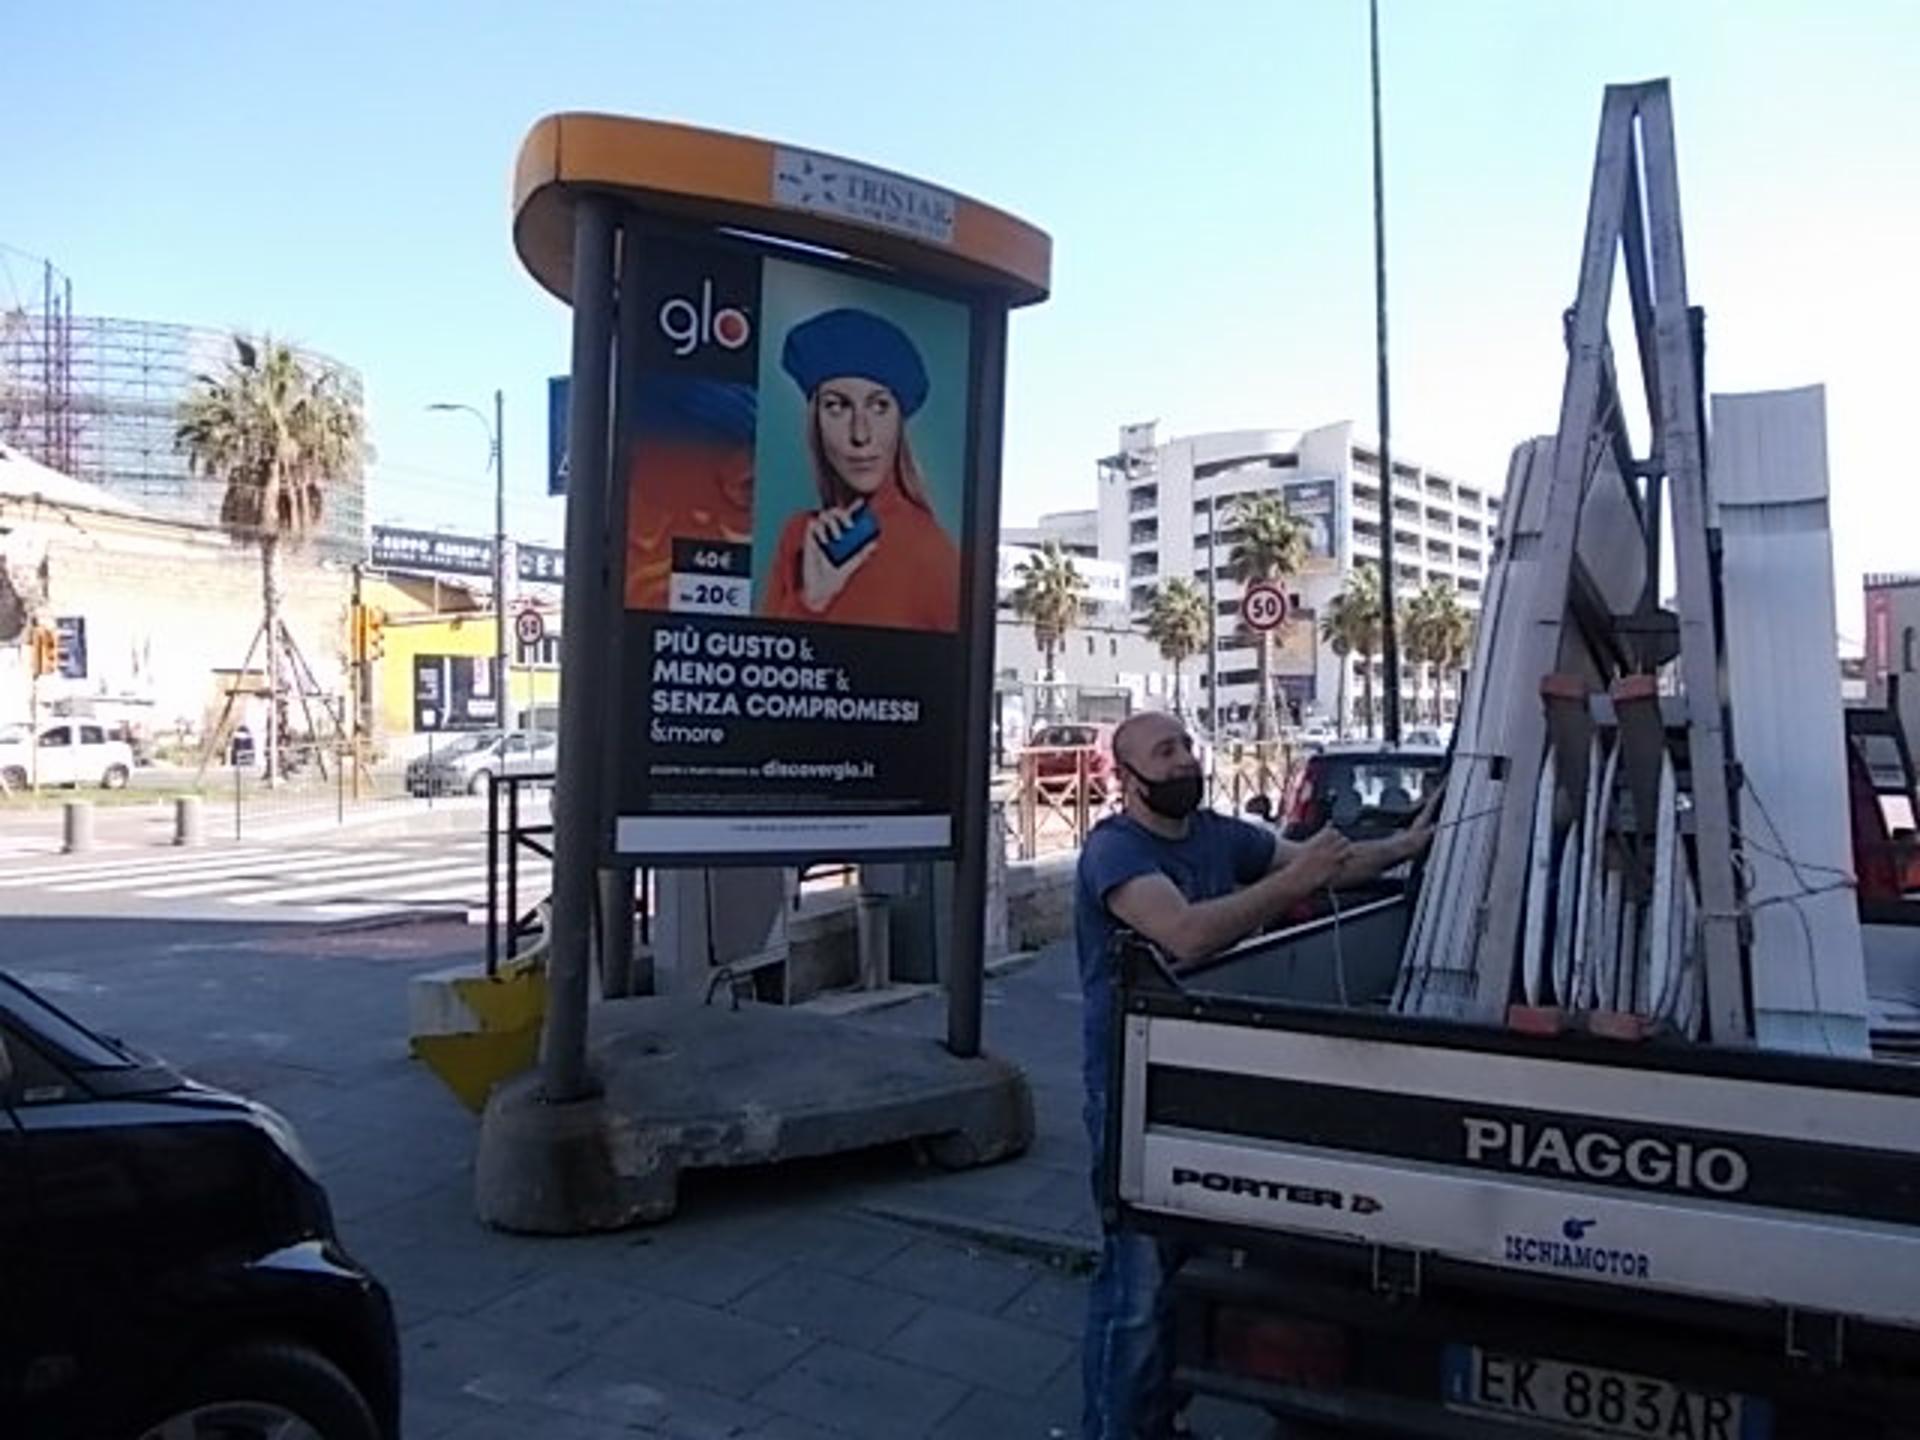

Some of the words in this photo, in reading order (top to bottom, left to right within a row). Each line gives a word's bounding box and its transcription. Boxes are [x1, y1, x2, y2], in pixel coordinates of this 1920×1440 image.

[659, 278, 749, 355] glo
[1252, 593, 1277, 617] 50
[654, 624, 699, 655] PIÙ
[705, 632, 797, 660] GUSTO
[800, 637, 815, 661] &
[653, 659, 736, 685] MENO
[740, 665, 828, 691] ODORE
[835, 667, 850, 692] &
[652, 690, 741, 716] SENZA
[745, 693, 920, 722] COMPROMESSI
[1463, 1117, 1748, 1194] PIAGGIO
[1172, 1166, 1343, 1211] PORTER
[1505, 1234, 1651, 1279] ISCHIAMOTOR
[1479, 1352, 1537, 1411] EK
